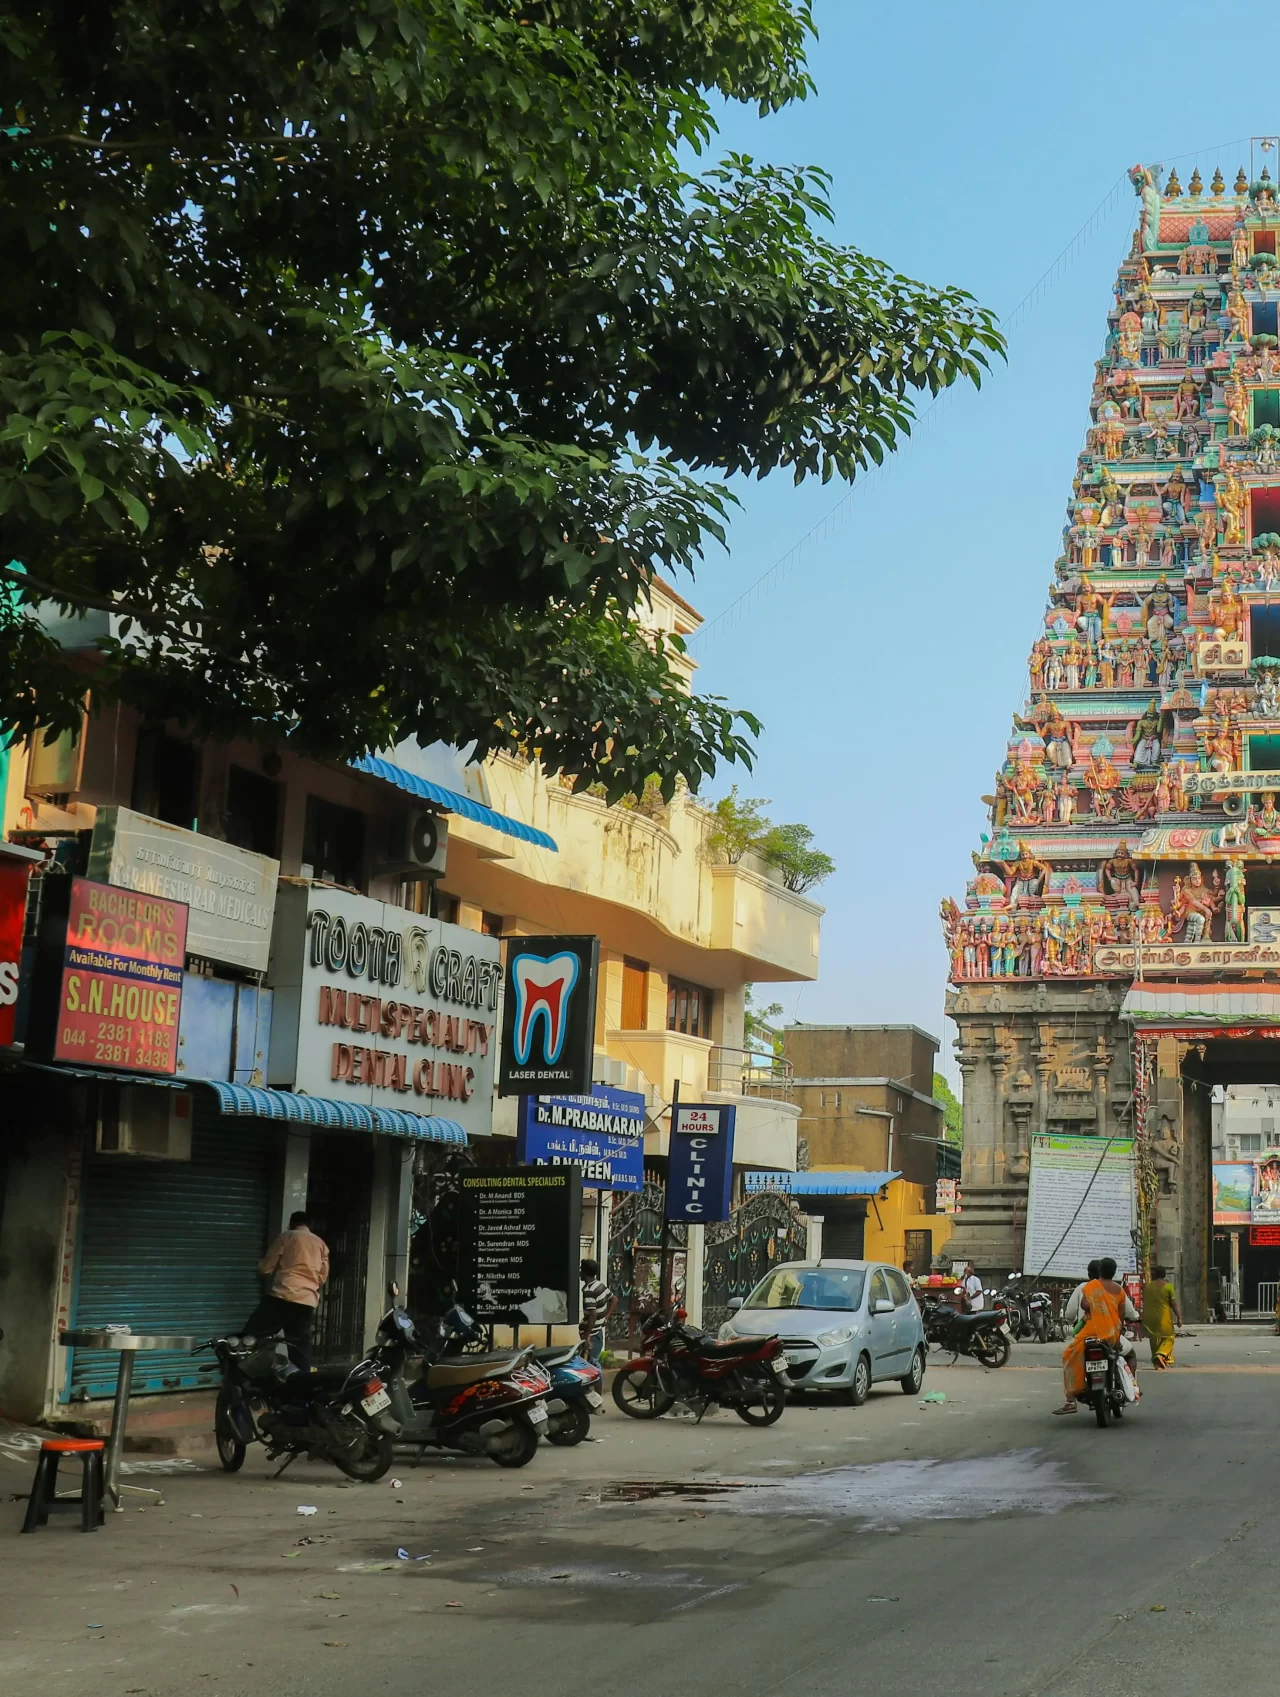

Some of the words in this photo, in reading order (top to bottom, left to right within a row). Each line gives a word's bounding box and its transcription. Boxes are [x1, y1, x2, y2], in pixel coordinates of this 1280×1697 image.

[1203, 644, 1243, 665] சிவ
[88, 889, 175, 928] BACHELOR'S
[113, 864, 216, 916] KARANEESWARAR
[217, 895, 271, 931] MEDICALS
[77, 912, 178, 959] ROOMS
[69, 949, 112, 970] Available
[113, 957, 128, 972] For
[128, 961, 163, 982] Monthly
[163, 966, 182, 983] Rent
[307, 909, 402, 986] TOOTH
[429, 945, 504, 1011] CRAFT
[1102, 947, 1192, 967] அருள்மிகு
[66, 975, 179, 1027] S.N.HOUSE
[63, 1027, 86, 1046] 044
[97, 1022, 132, 1043] 2381
[139, 1028, 170, 1049] 1183
[95, 1043, 130, 1063] 2381
[135, 1048, 169, 1068] 3438
[331, 1042, 412, 1092] DENTAL
[413, 1058, 475, 1101] CLINIC
[509, 1071, 536, 1079] LASER
[537, 1071, 570, 1079] DENTAL
[538, 1106, 551, 1124] Dr.
[681, 1123, 714, 1131] HOURS
[690, 1112, 707, 1121] 24
[463, 1177, 501, 1188] CONSULTING
[502, 1177, 526, 1187] DENTAL
[527, 1176, 565, 1187] SPECIALISTS
[685, 1138, 707, 1213] CLINIC
